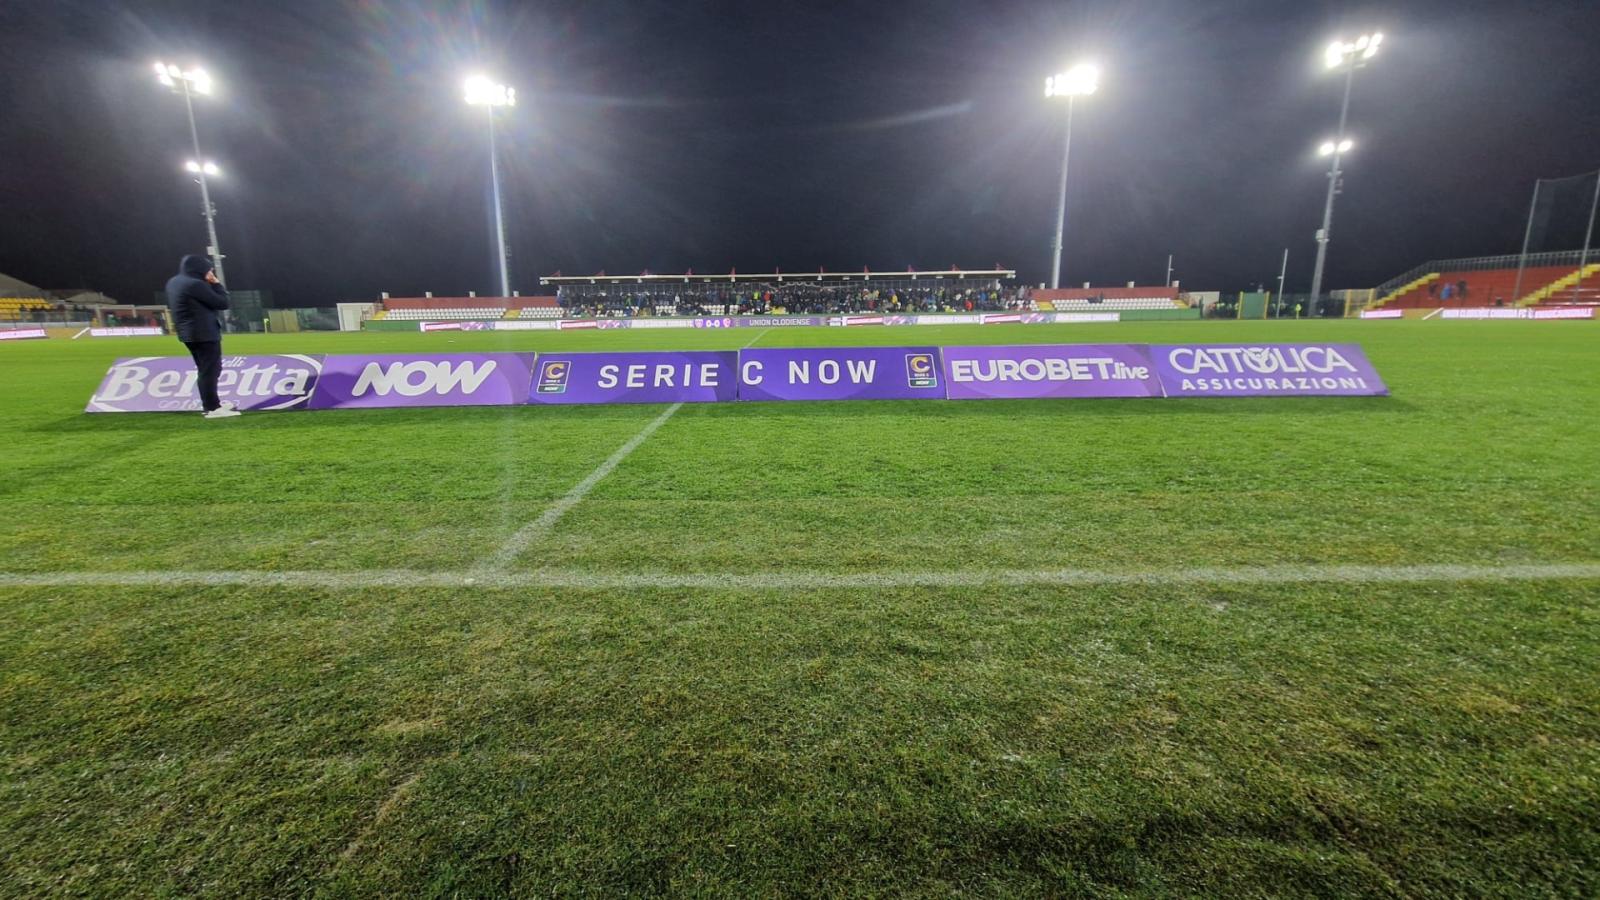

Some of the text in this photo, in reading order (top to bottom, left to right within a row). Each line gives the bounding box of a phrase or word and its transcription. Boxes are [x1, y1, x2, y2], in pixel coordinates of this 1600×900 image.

[772, 318, 811, 326] CLODIENSE
[952, 358, 1149, 382] EUROBET.live
[1169, 346, 1357, 374] CATTOLICA
[351, 360, 496, 396] NOW
[597, 359, 877, 388] SERIE C NOW
[1181, 377, 1367, 390] ASSICURAZIONI
